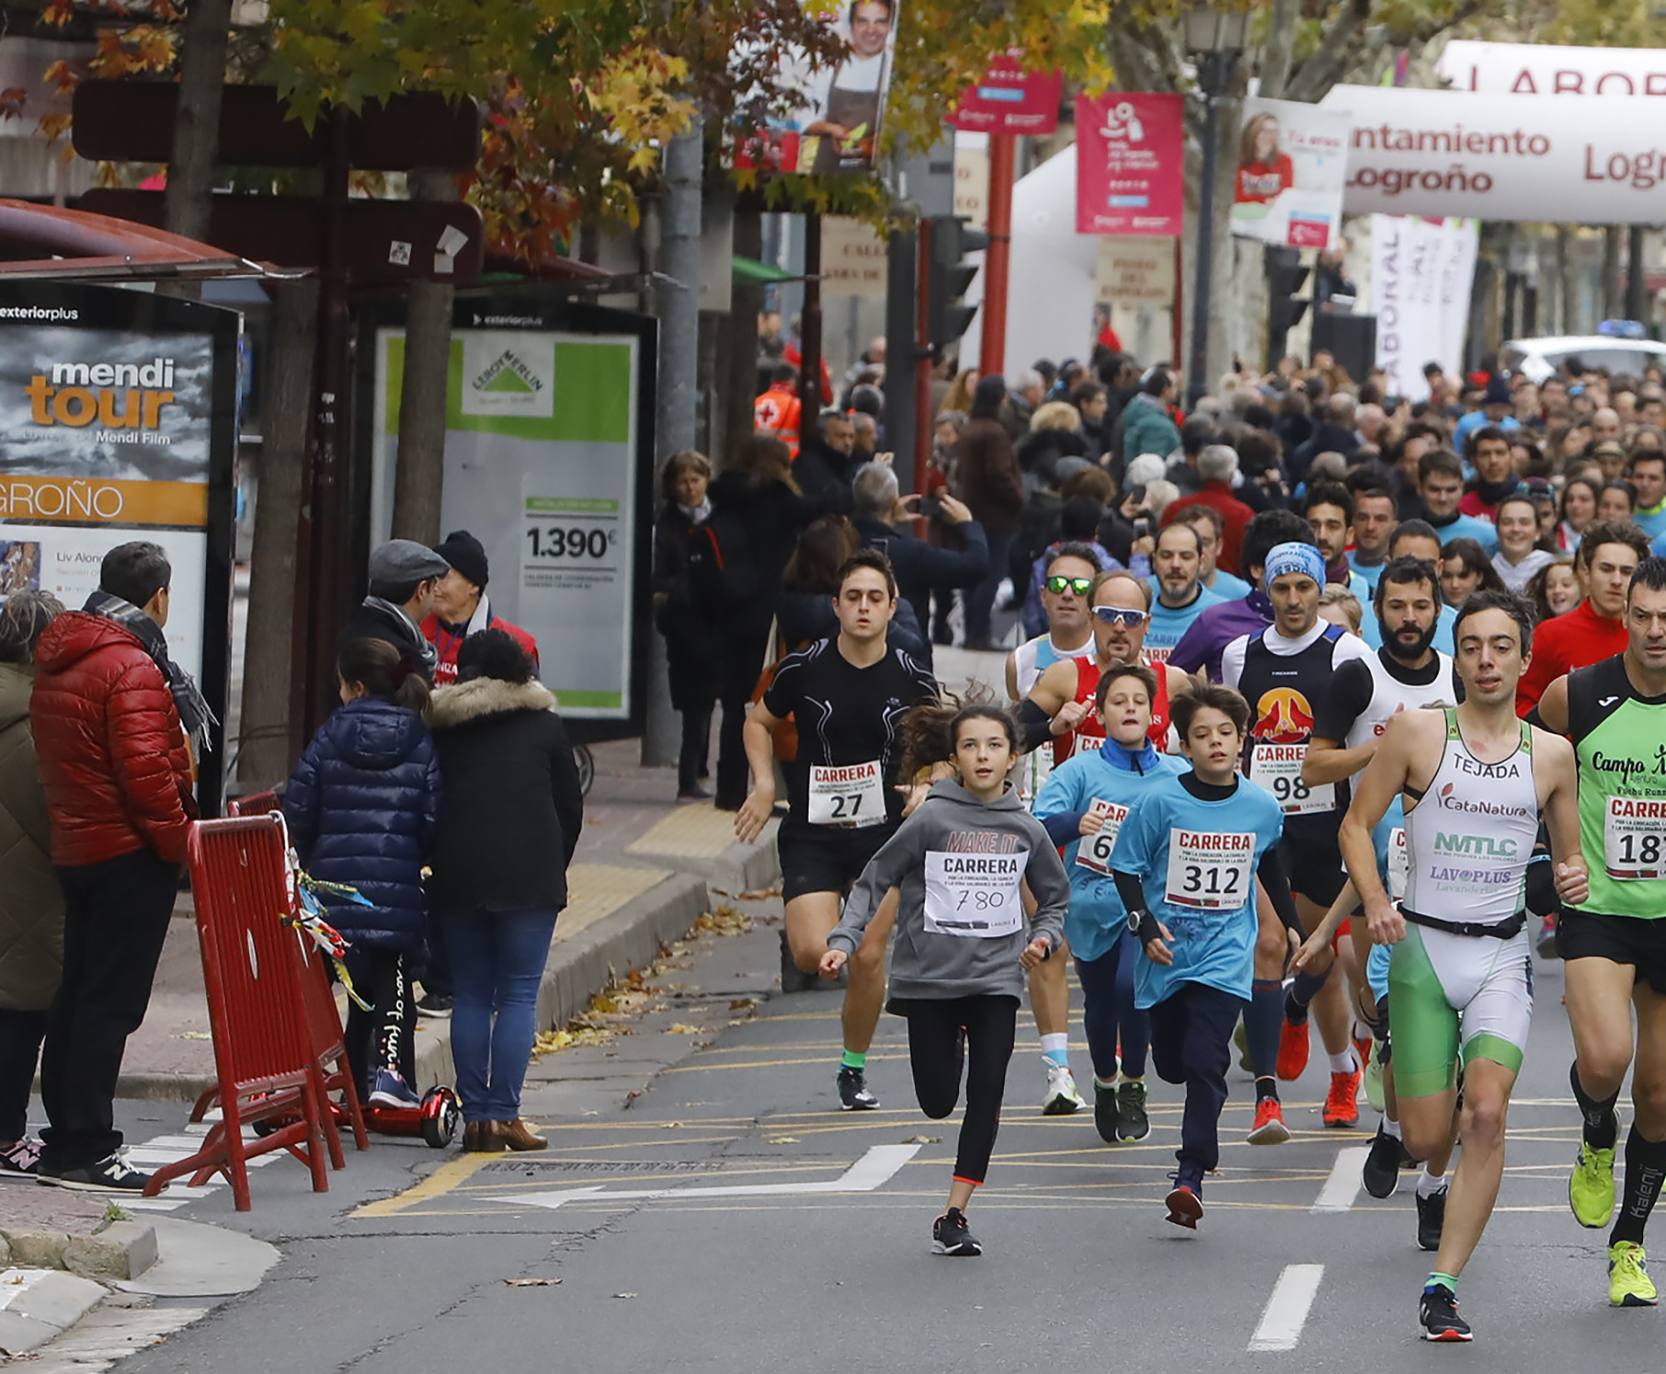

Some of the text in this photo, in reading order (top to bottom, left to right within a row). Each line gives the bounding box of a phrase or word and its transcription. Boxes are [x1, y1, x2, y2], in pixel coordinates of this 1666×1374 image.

[1345, 162, 1494, 196] ogroño
[0, 305, 79, 322] exteriorplus
[52, 357, 175, 388] mendi
[472, 349, 544, 392] LEROY MERLIN
[25, 374, 176, 430] tour
[96, 430, 138, 444] Mendi
[142, 432, 171, 446] Film
[0, 479, 123, 518] ROÑO
[56, 552, 73, 563] Liv
[1256, 746, 1308, 762] CARRE
[1453, 752, 1520, 779] TEJADA
[815, 763, 876, 782] CARRERA
[1591, 751, 1646, 785] Campo
[1272, 776, 1311, 801] 98
[830, 792, 863, 819] 27
[1444, 795, 1528, 817] CataNatura
[945, 831, 1020, 854] MAKE IT
[1179, 831, 1250, 851] CARRERA
[944, 857, 1018, 874] CARRERA
[1182, 865, 1240, 895] 312
[956, 889, 1005, 912] 780
